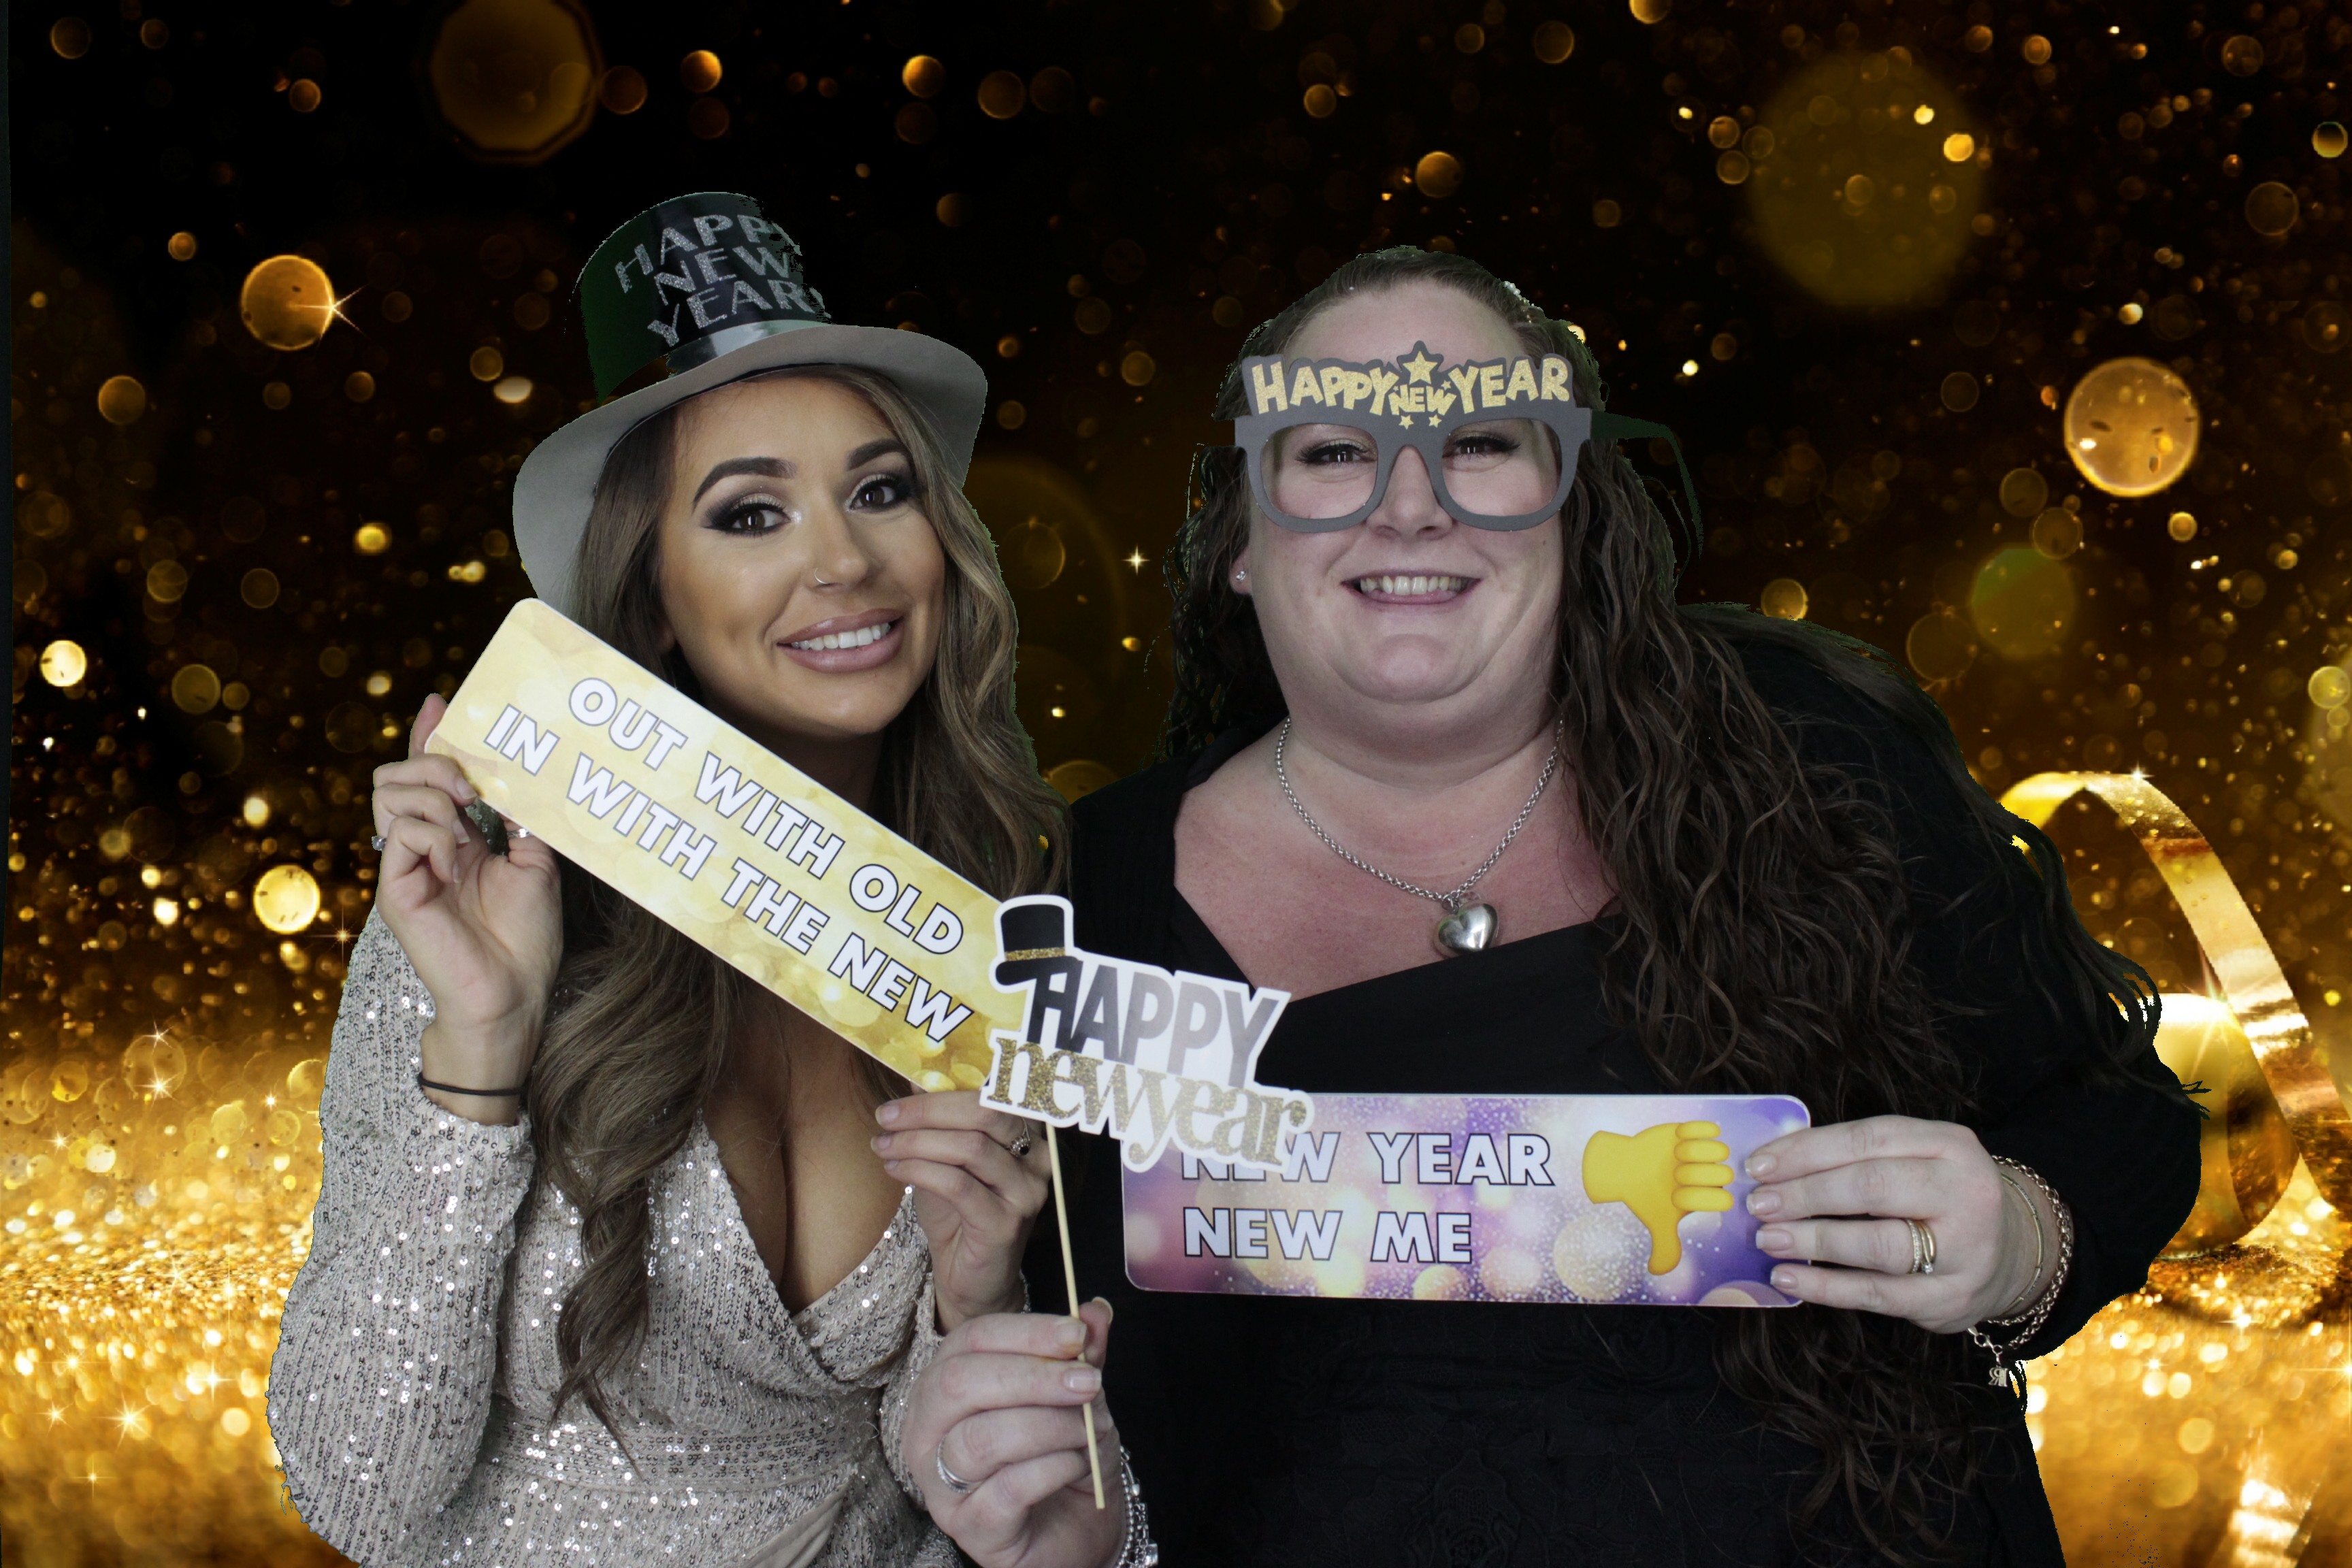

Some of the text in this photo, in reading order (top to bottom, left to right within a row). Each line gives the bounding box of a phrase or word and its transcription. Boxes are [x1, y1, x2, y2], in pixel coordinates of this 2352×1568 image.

[654, 246, 789, 305] NEW
[1252, 358, 1570, 416] HAPPY NEW YEAR
[569, 678, 964, 954] OUT WITH OLD
[485, 704, 974, 1043] IN WITH THE NEW
[1026, 956, 1280, 1088] HAPPY
[1368, 1132, 1555, 1186] YEAR
[1183, 1207, 1471, 1264] NEW ME
